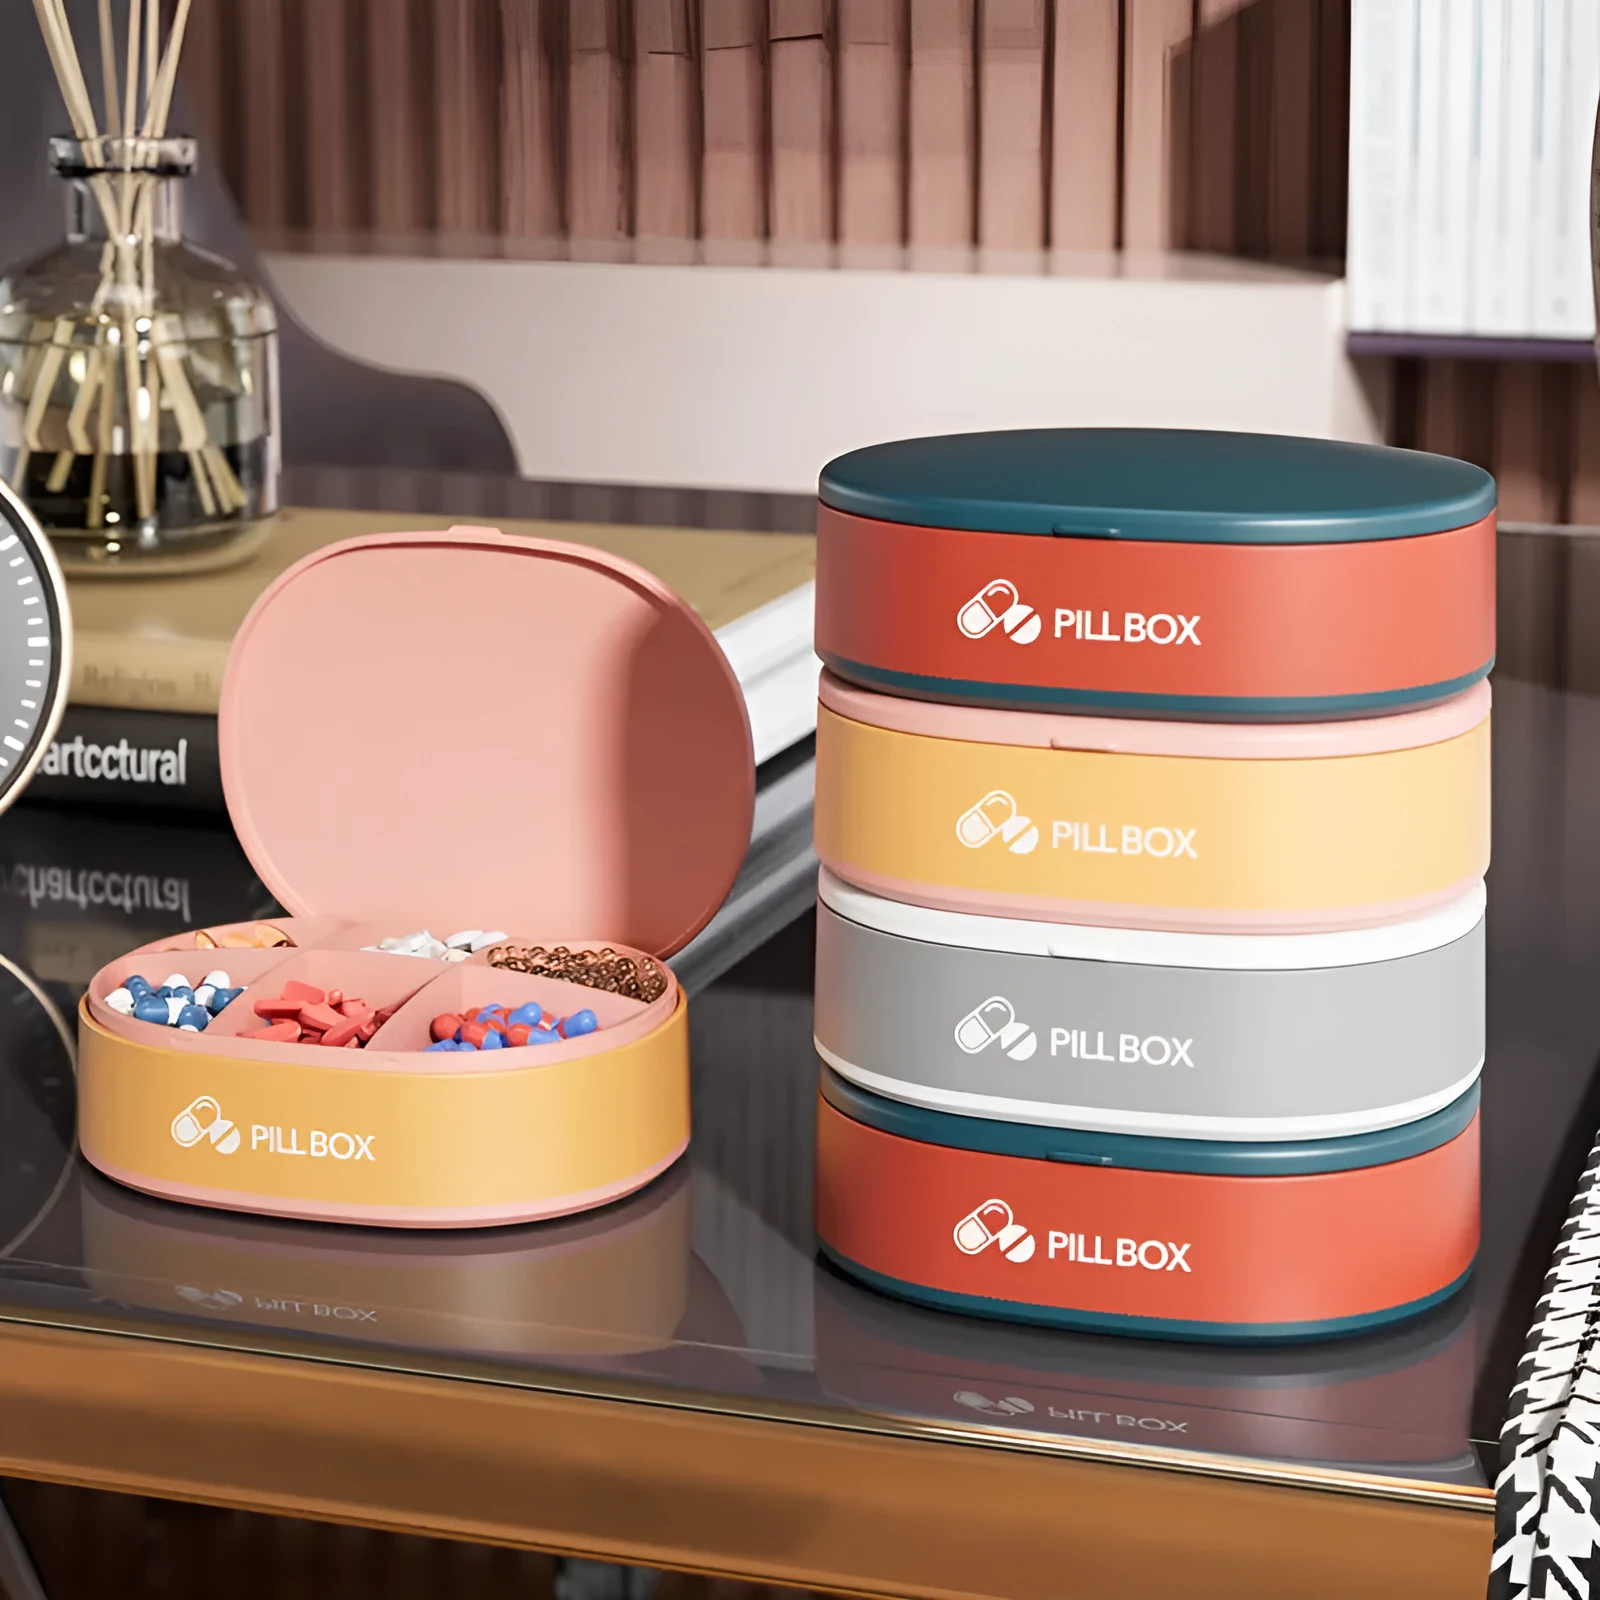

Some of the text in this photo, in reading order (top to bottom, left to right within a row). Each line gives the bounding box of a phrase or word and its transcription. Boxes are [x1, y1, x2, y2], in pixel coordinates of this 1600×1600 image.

[1054, 608, 1202, 646] PILL BOX
[38, 735, 187, 785] artcctural
[1051, 820, 1198, 859] PILL BOX
[1050, 1027, 1195, 1068] PILL BOX
[251, 1124, 376, 1161] PILL BOX
[1048, 1230, 1192, 1272] PILL BOX
